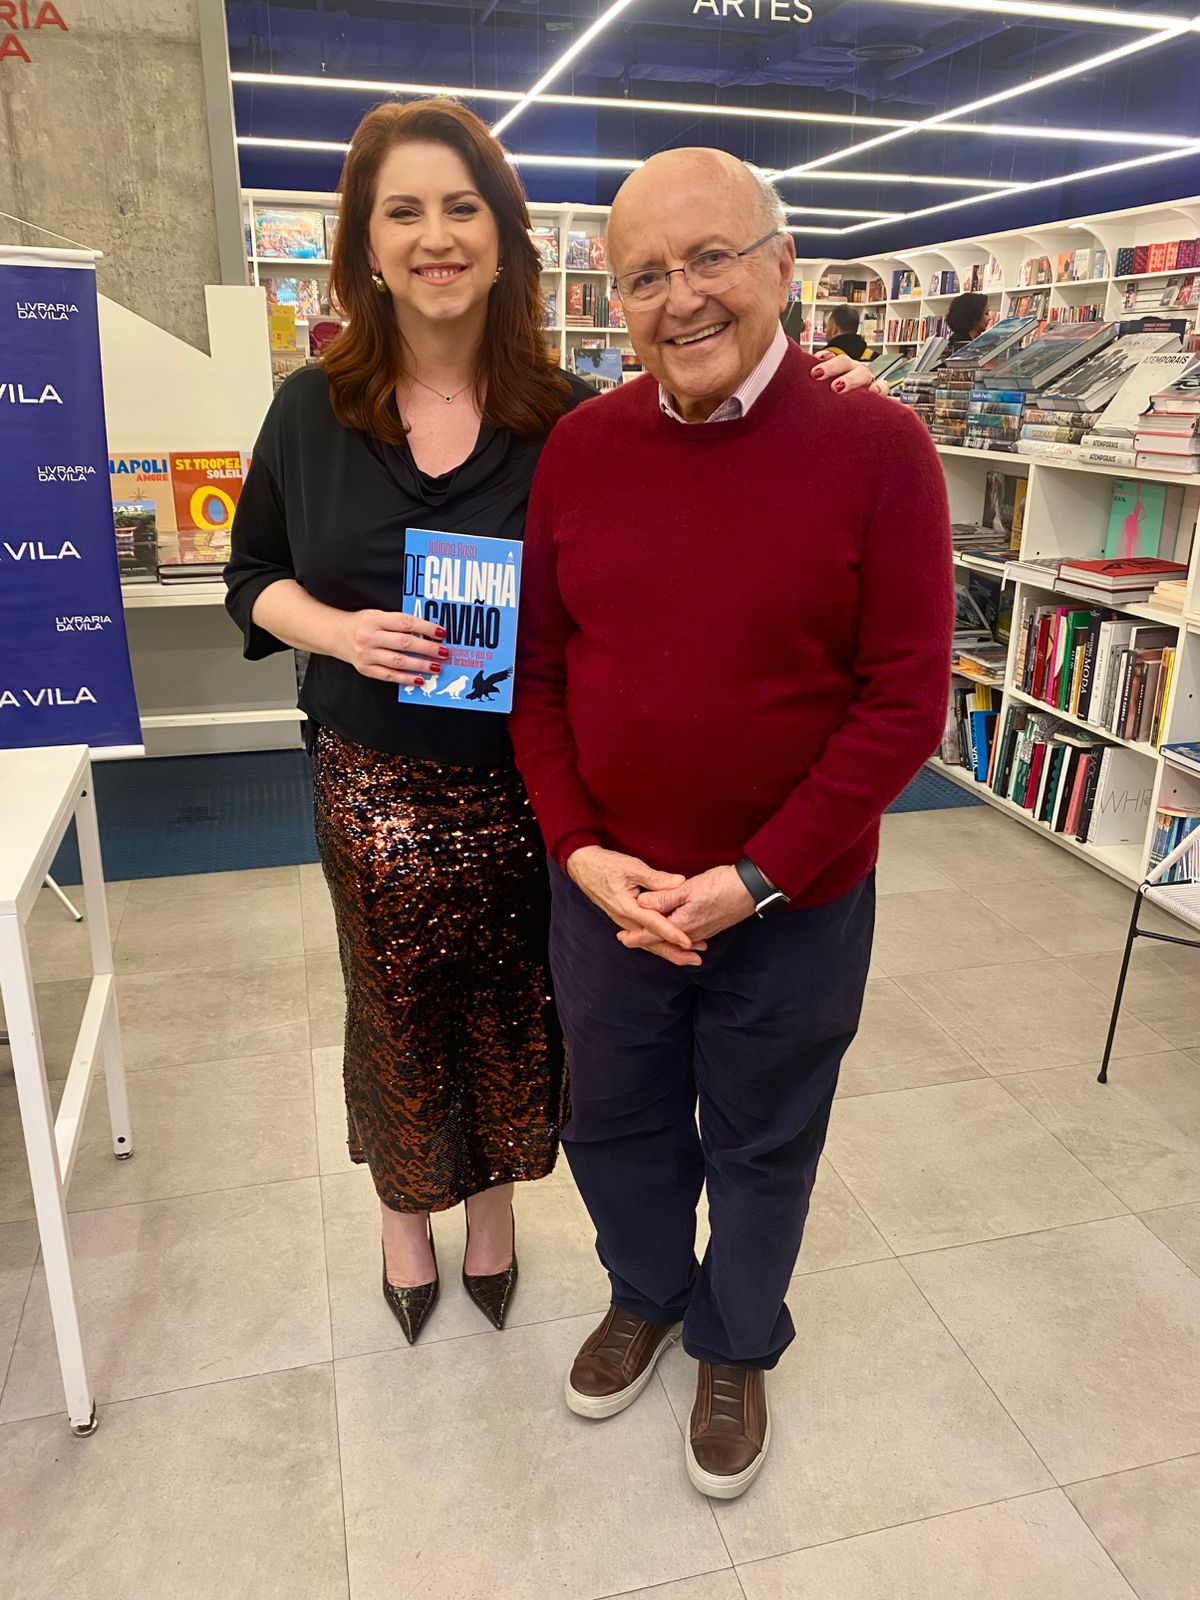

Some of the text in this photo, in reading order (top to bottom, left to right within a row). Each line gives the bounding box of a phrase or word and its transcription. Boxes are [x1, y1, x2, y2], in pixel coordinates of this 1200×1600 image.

[16, 302, 79, 313] LIVRARIA
[18, 311, 69, 321] DA VILA
[1141, 355, 1189, 364] ATEMPORAIS
[0, 384, 63, 404] ILA
[1092, 439, 1118, 449] ATEMPORAIS
[1089, 453, 1116, 463] ATEMPORAIS
[37, 465, 96, 474] LIVRARIA
[206, 469, 242, 479] SOLEIL
[38, 473, 87, 481] DA VILA
[136, 474, 168, 482] AMORE
[3, 541, 81, 560] VILA
[403, 553, 516, 608] DE GALINHA
[55, 615, 112, 624] LIVRARIA
[56, 623, 104, 632] DA VILA
[1080, 656, 1091, 694] MODA
[23, 686, 98, 706] VILA
